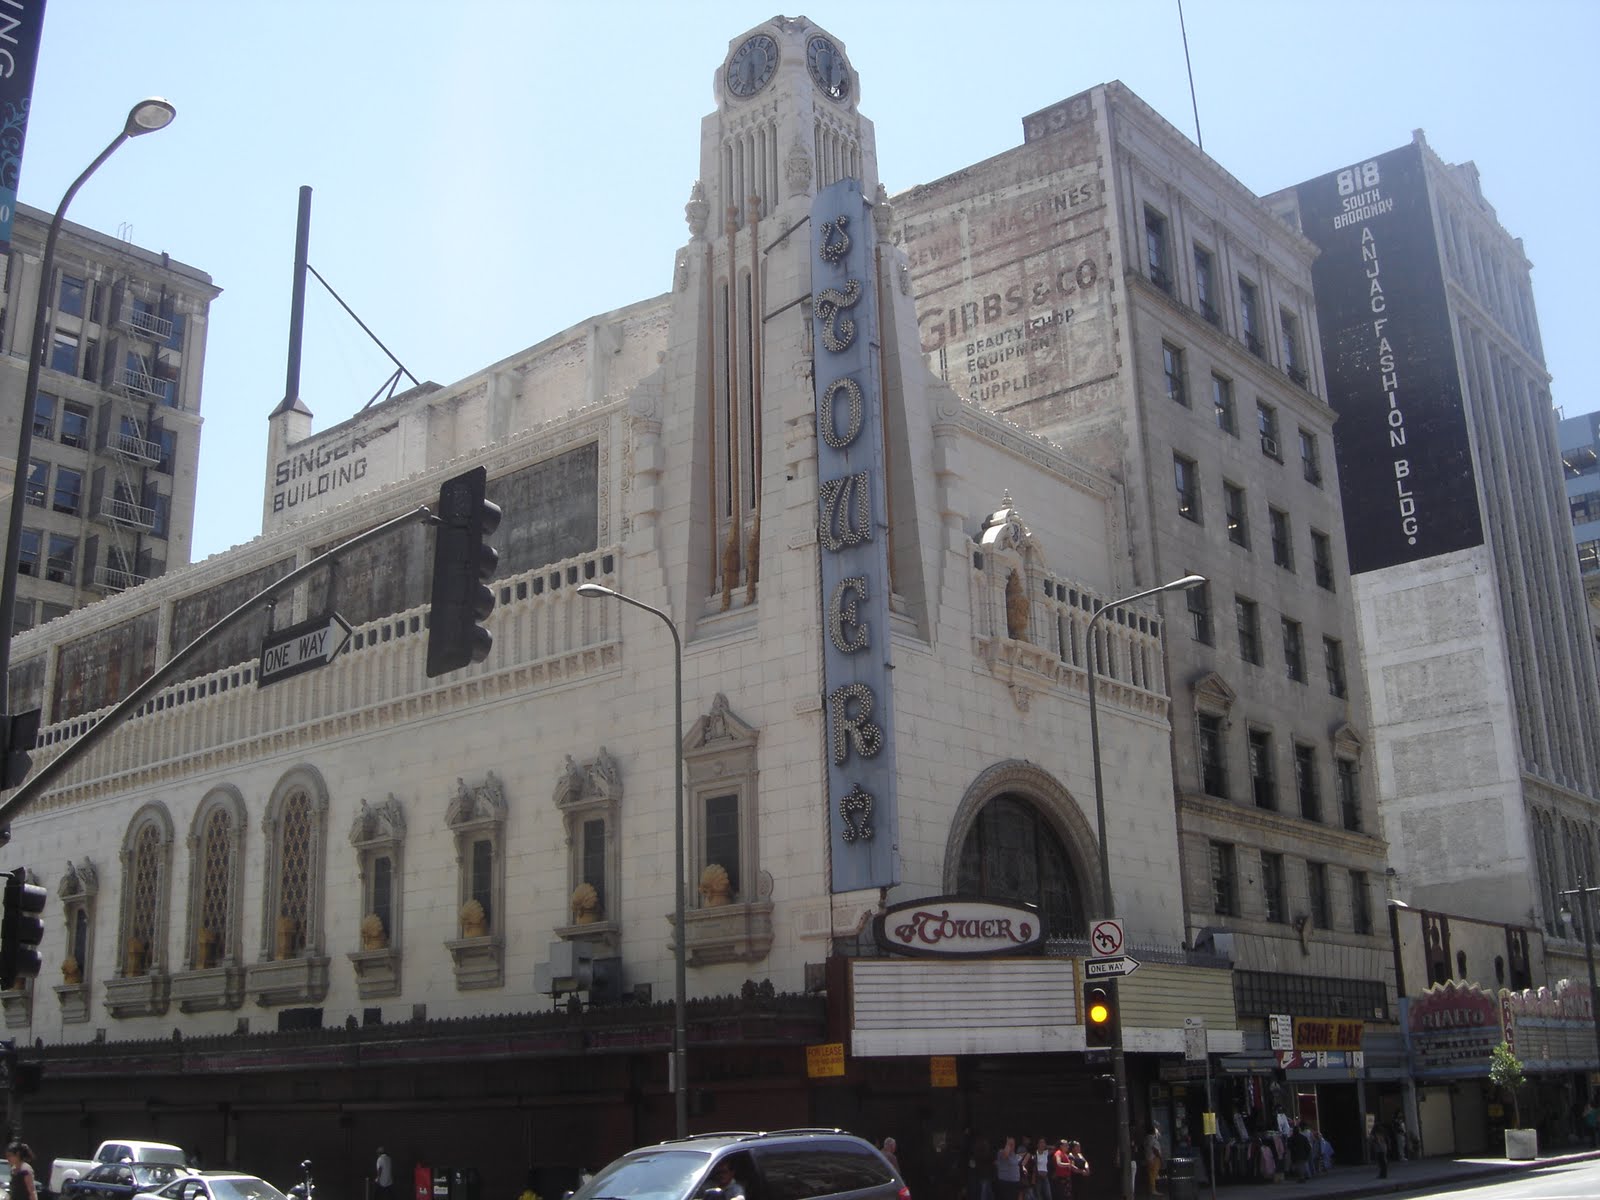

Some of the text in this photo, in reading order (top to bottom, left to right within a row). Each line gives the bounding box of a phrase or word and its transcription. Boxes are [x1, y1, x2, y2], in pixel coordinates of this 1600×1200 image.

[1337, 161, 1380, 196] 818
[1334, 197, 1393, 229] BROADWAY
[1343, 188, 1380, 212] SOUTH
[1056, 258, 1098, 296] CO
[966, 324, 1025, 357] BEAUTY
[1361, 227, 1386, 313] ANJAC
[1374, 318, 1406, 447] FASHION
[968, 369, 1000, 388] AND
[273, 457, 368, 513] BUILDING
[814, 278, 883, 766] TOWER
[265, 630, 328, 673] ONE WAY
[1090, 962, 1124, 973] ONE WAY
[1422, 1007, 1485, 1028] RIALTO
[1503, 1001, 1514, 1053] RIALT
